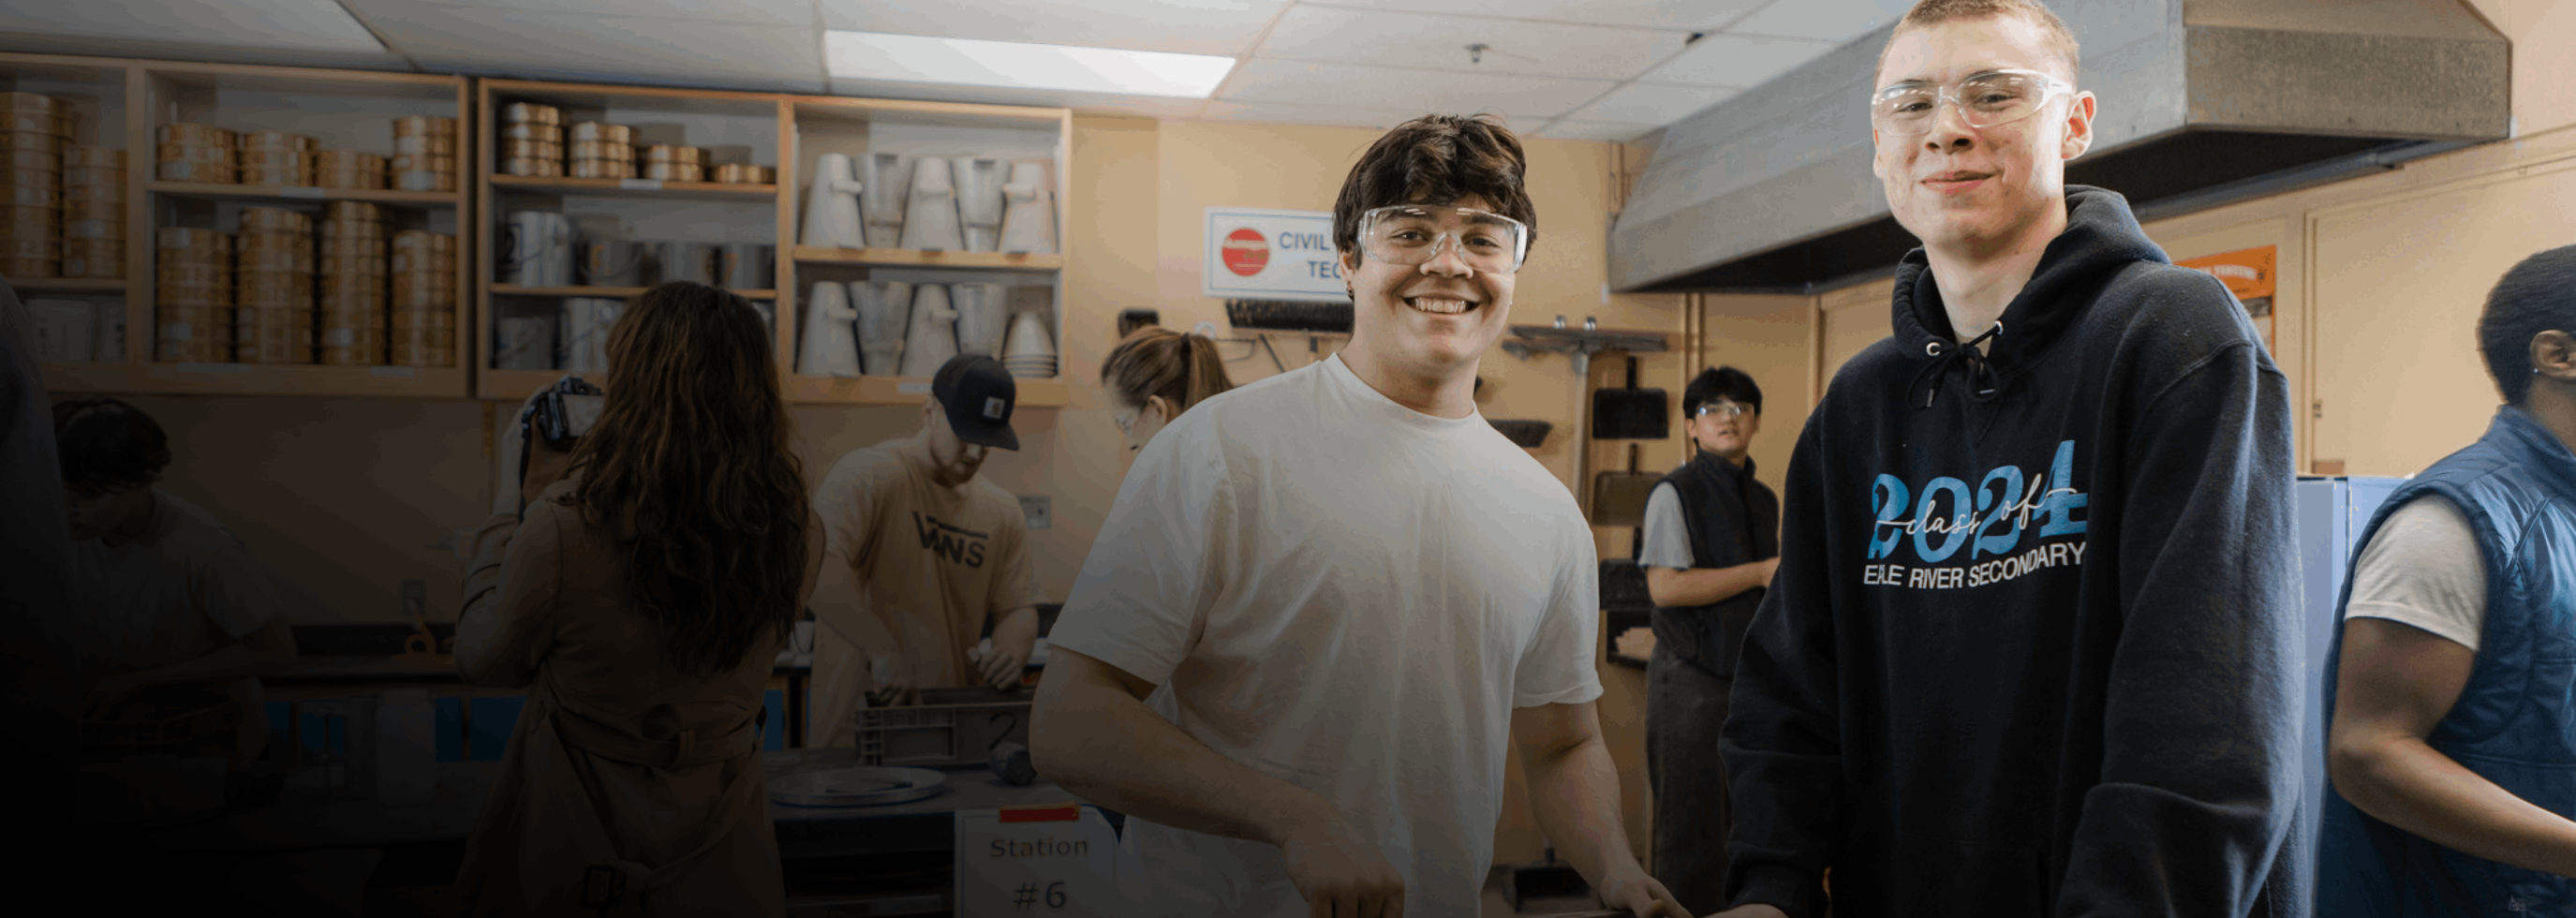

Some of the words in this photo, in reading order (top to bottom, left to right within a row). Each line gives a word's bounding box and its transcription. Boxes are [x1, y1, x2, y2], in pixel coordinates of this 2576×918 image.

[1280, 231, 1330, 251] CIVIL
[1868, 439, 2088, 563] 2024
[1876, 499, 1981, 535] class
[2001, 473, 2078, 530] of
[912, 511, 987, 569] VANS
[1908, 568, 1964, 589] RIVER
[1968, 541, 2086, 587] SECONDARY
[990, 837, 1088, 859] Station
[1013, 881, 1067, 911] #6
